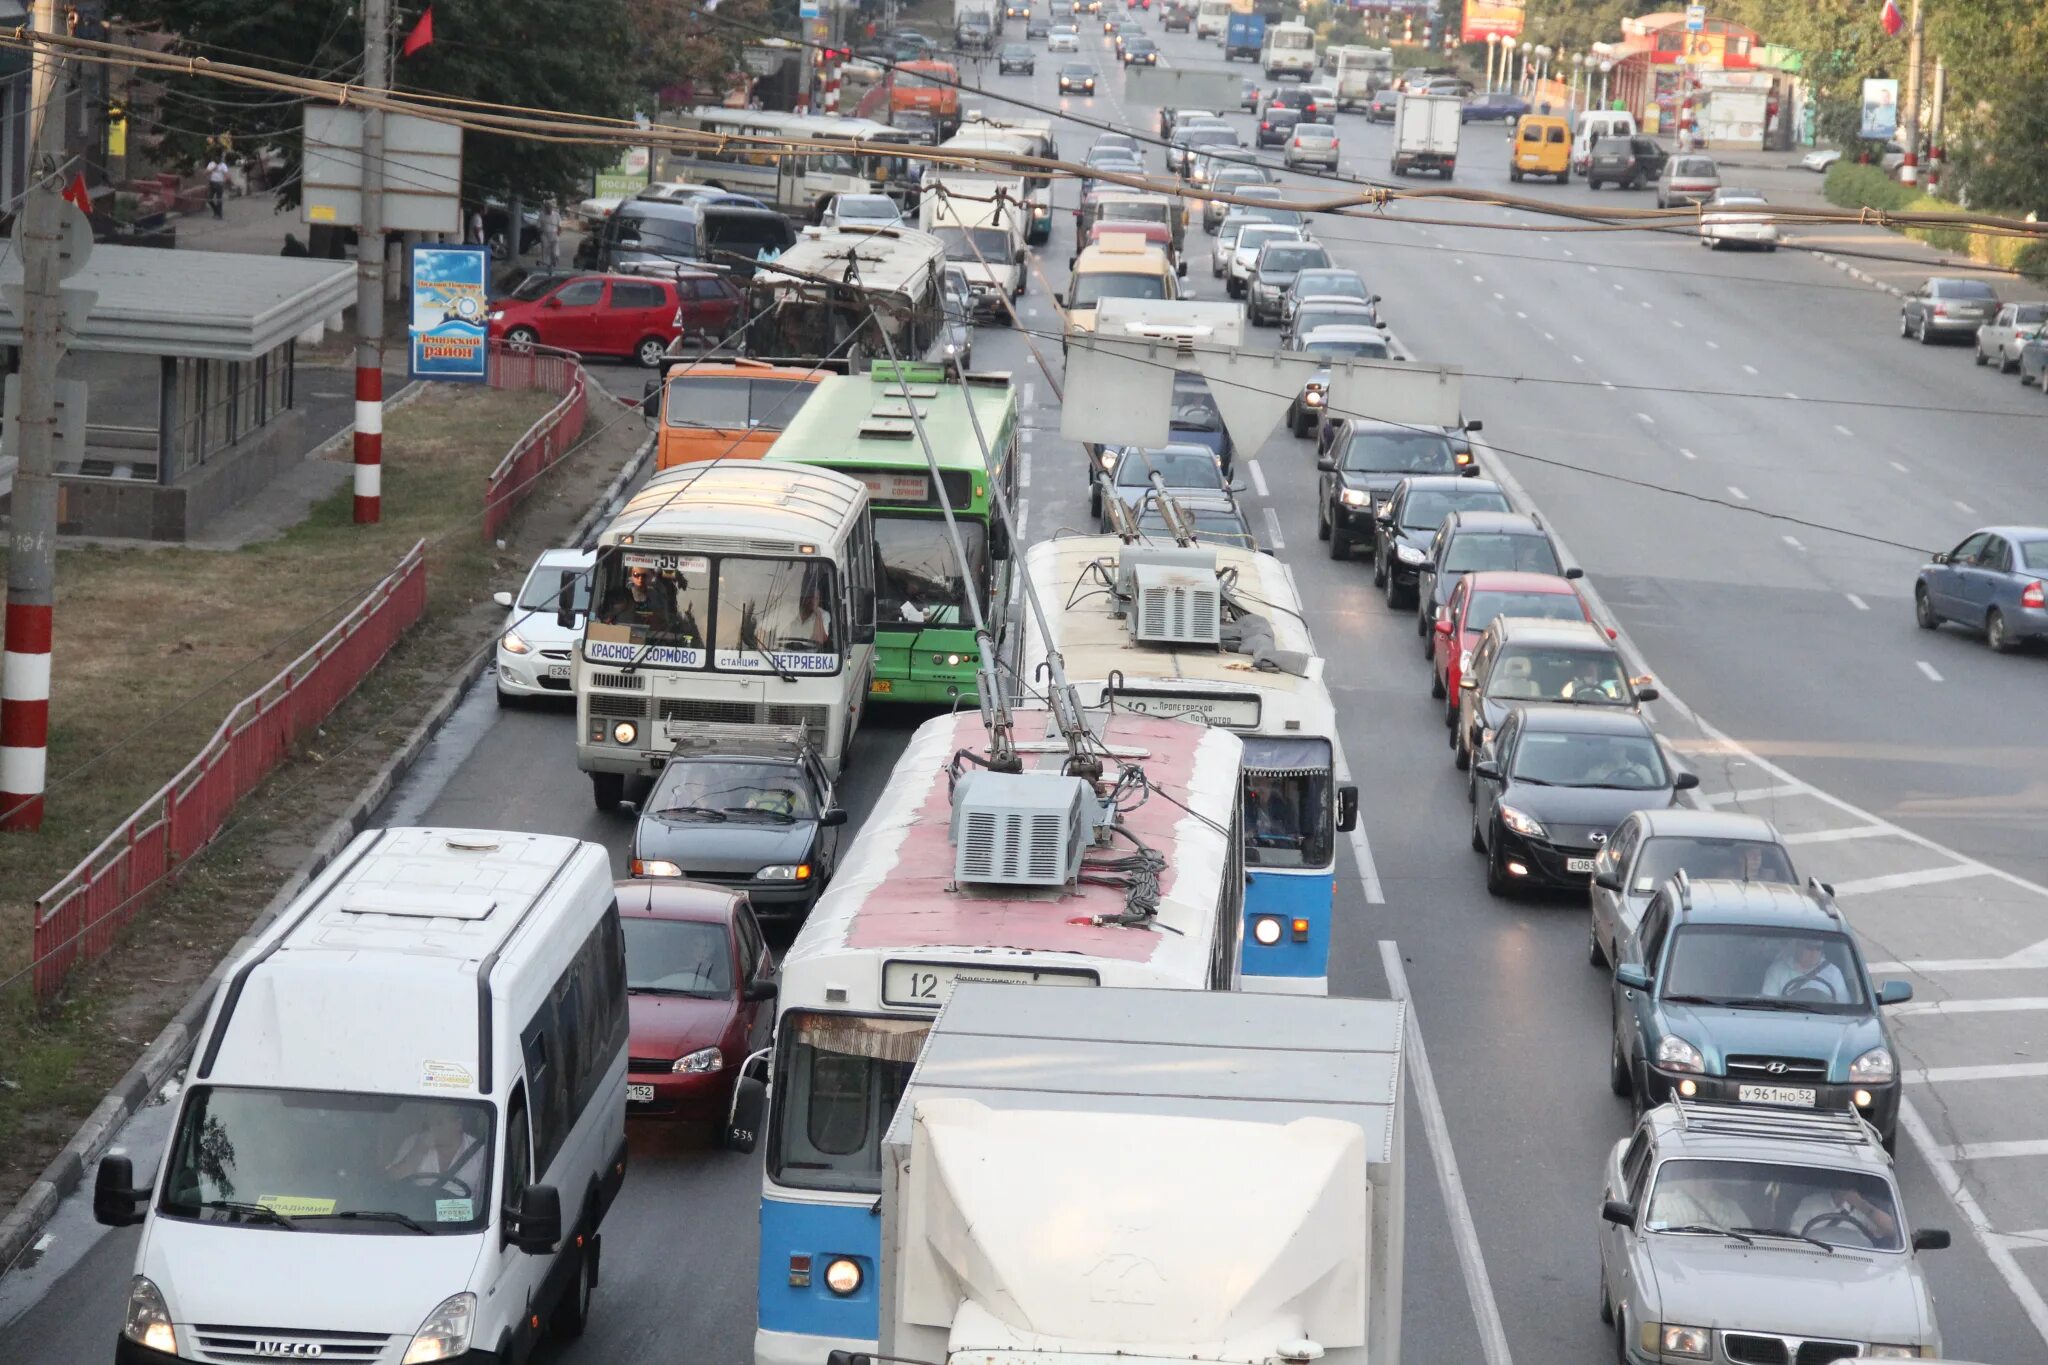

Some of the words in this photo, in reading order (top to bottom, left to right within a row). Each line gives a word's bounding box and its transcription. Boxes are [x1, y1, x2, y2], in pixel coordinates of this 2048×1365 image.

[425, 346, 472, 359] район
[591, 643, 636, 660] КРАСНОЕ
[645, 647, 697, 665] СОРМОВО
[720, 658, 759, 667] СТАНЦИЯ
[772, 654, 834, 670] ПЕТРЯЕВКА
[910, 973, 938, 998] 12
[632, 1086, 651, 1096] 152
[733, 1128, 753, 1141] 538
[266, 1203, 330, 1213] ВЛАДИМИР
[254, 1341, 322, 1358] IVECO
